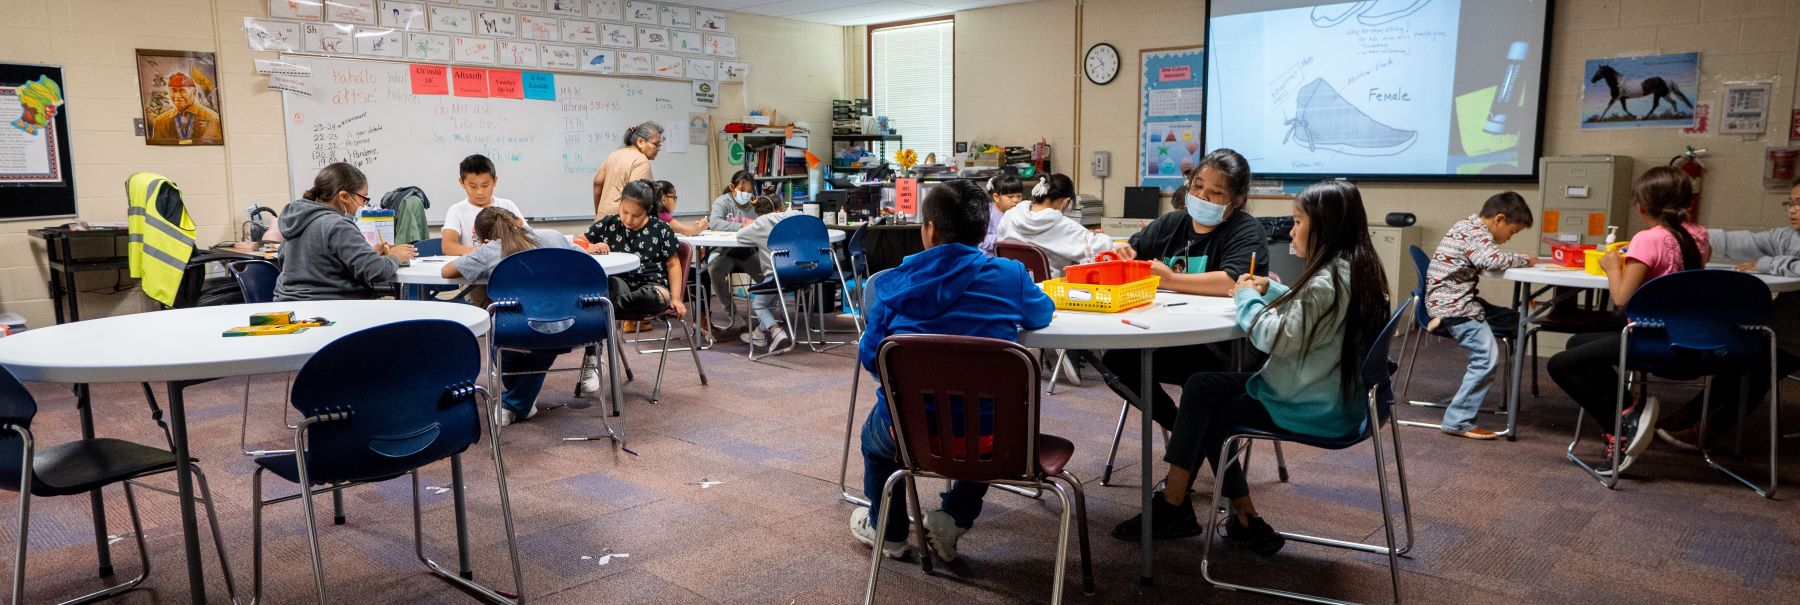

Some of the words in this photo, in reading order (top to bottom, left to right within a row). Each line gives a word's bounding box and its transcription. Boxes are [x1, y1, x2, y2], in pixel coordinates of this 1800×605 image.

[432, 6, 438, 15] K
[306, 25, 317, 34] Sh
[1369, 87, 1411, 101] Female
